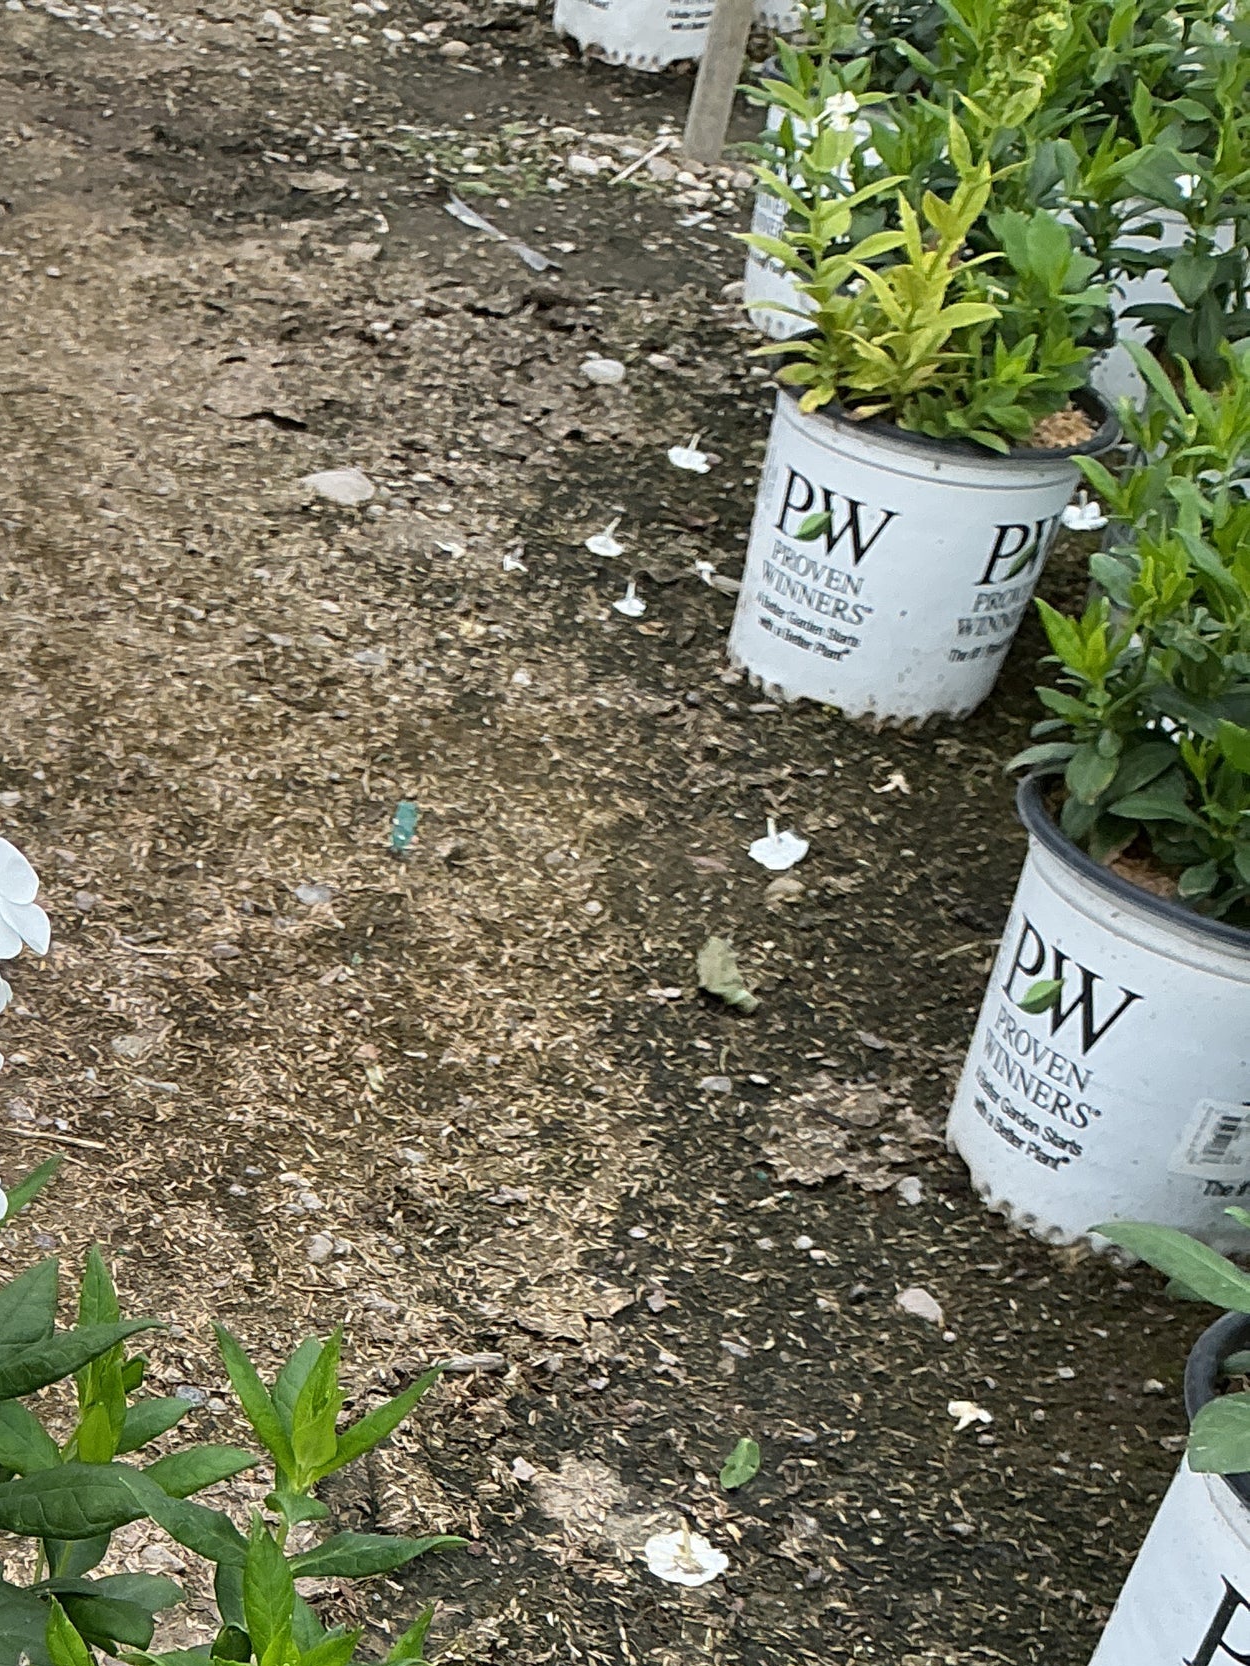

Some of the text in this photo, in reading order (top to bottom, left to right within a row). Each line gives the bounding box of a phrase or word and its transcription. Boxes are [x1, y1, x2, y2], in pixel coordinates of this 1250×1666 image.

[773, 464, 902, 566] PW
[772, 539, 864, 597] PROVEN
[1002, 913, 1144, 1055] PW
[995, 1004, 1093, 1093] PROVEN
[1000, 1096, 1040, 1136] Garden
[1041, 1126, 1083, 1156] Starts
